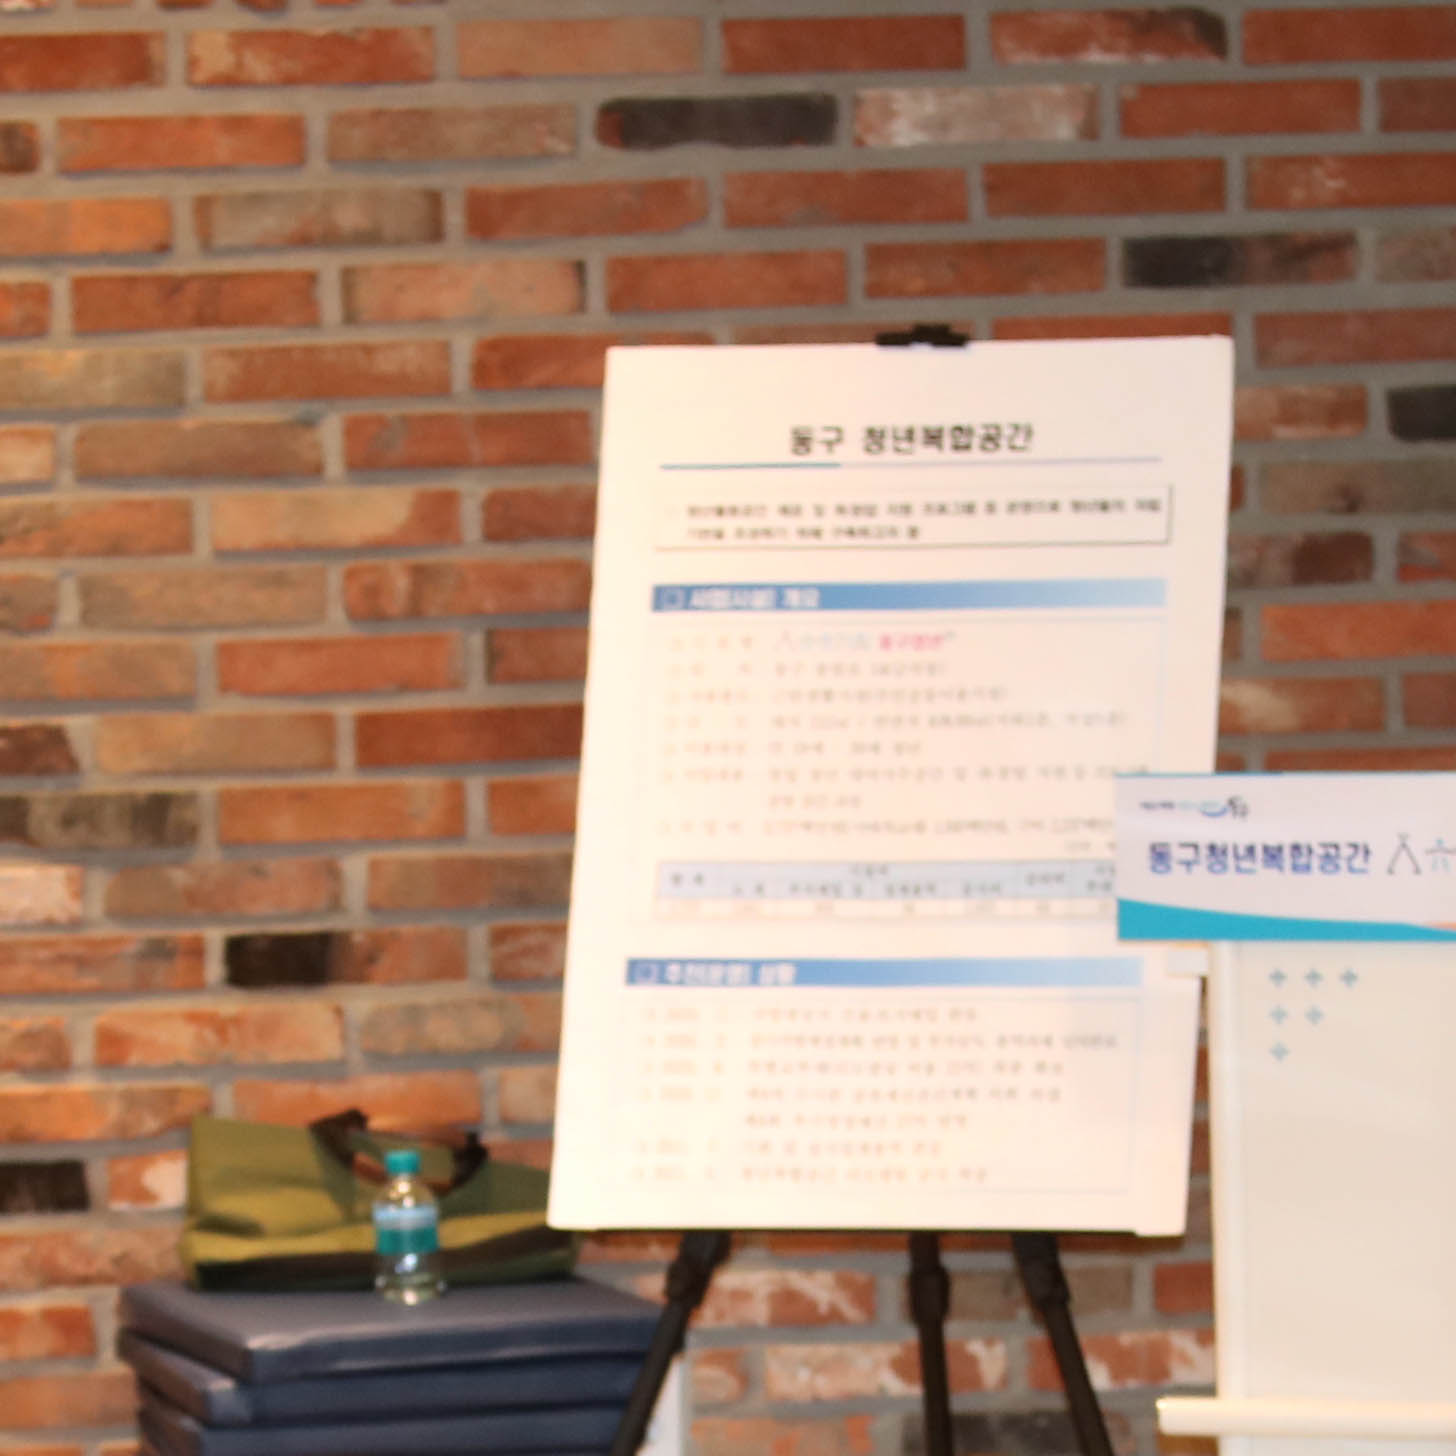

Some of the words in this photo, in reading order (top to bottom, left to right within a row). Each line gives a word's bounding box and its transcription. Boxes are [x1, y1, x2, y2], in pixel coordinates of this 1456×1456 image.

[791, 424, 843, 456] 동구
[863, 422, 1034, 456] 청년복합공간
[1148, 841, 1372, 875] 동구청년복합공간
